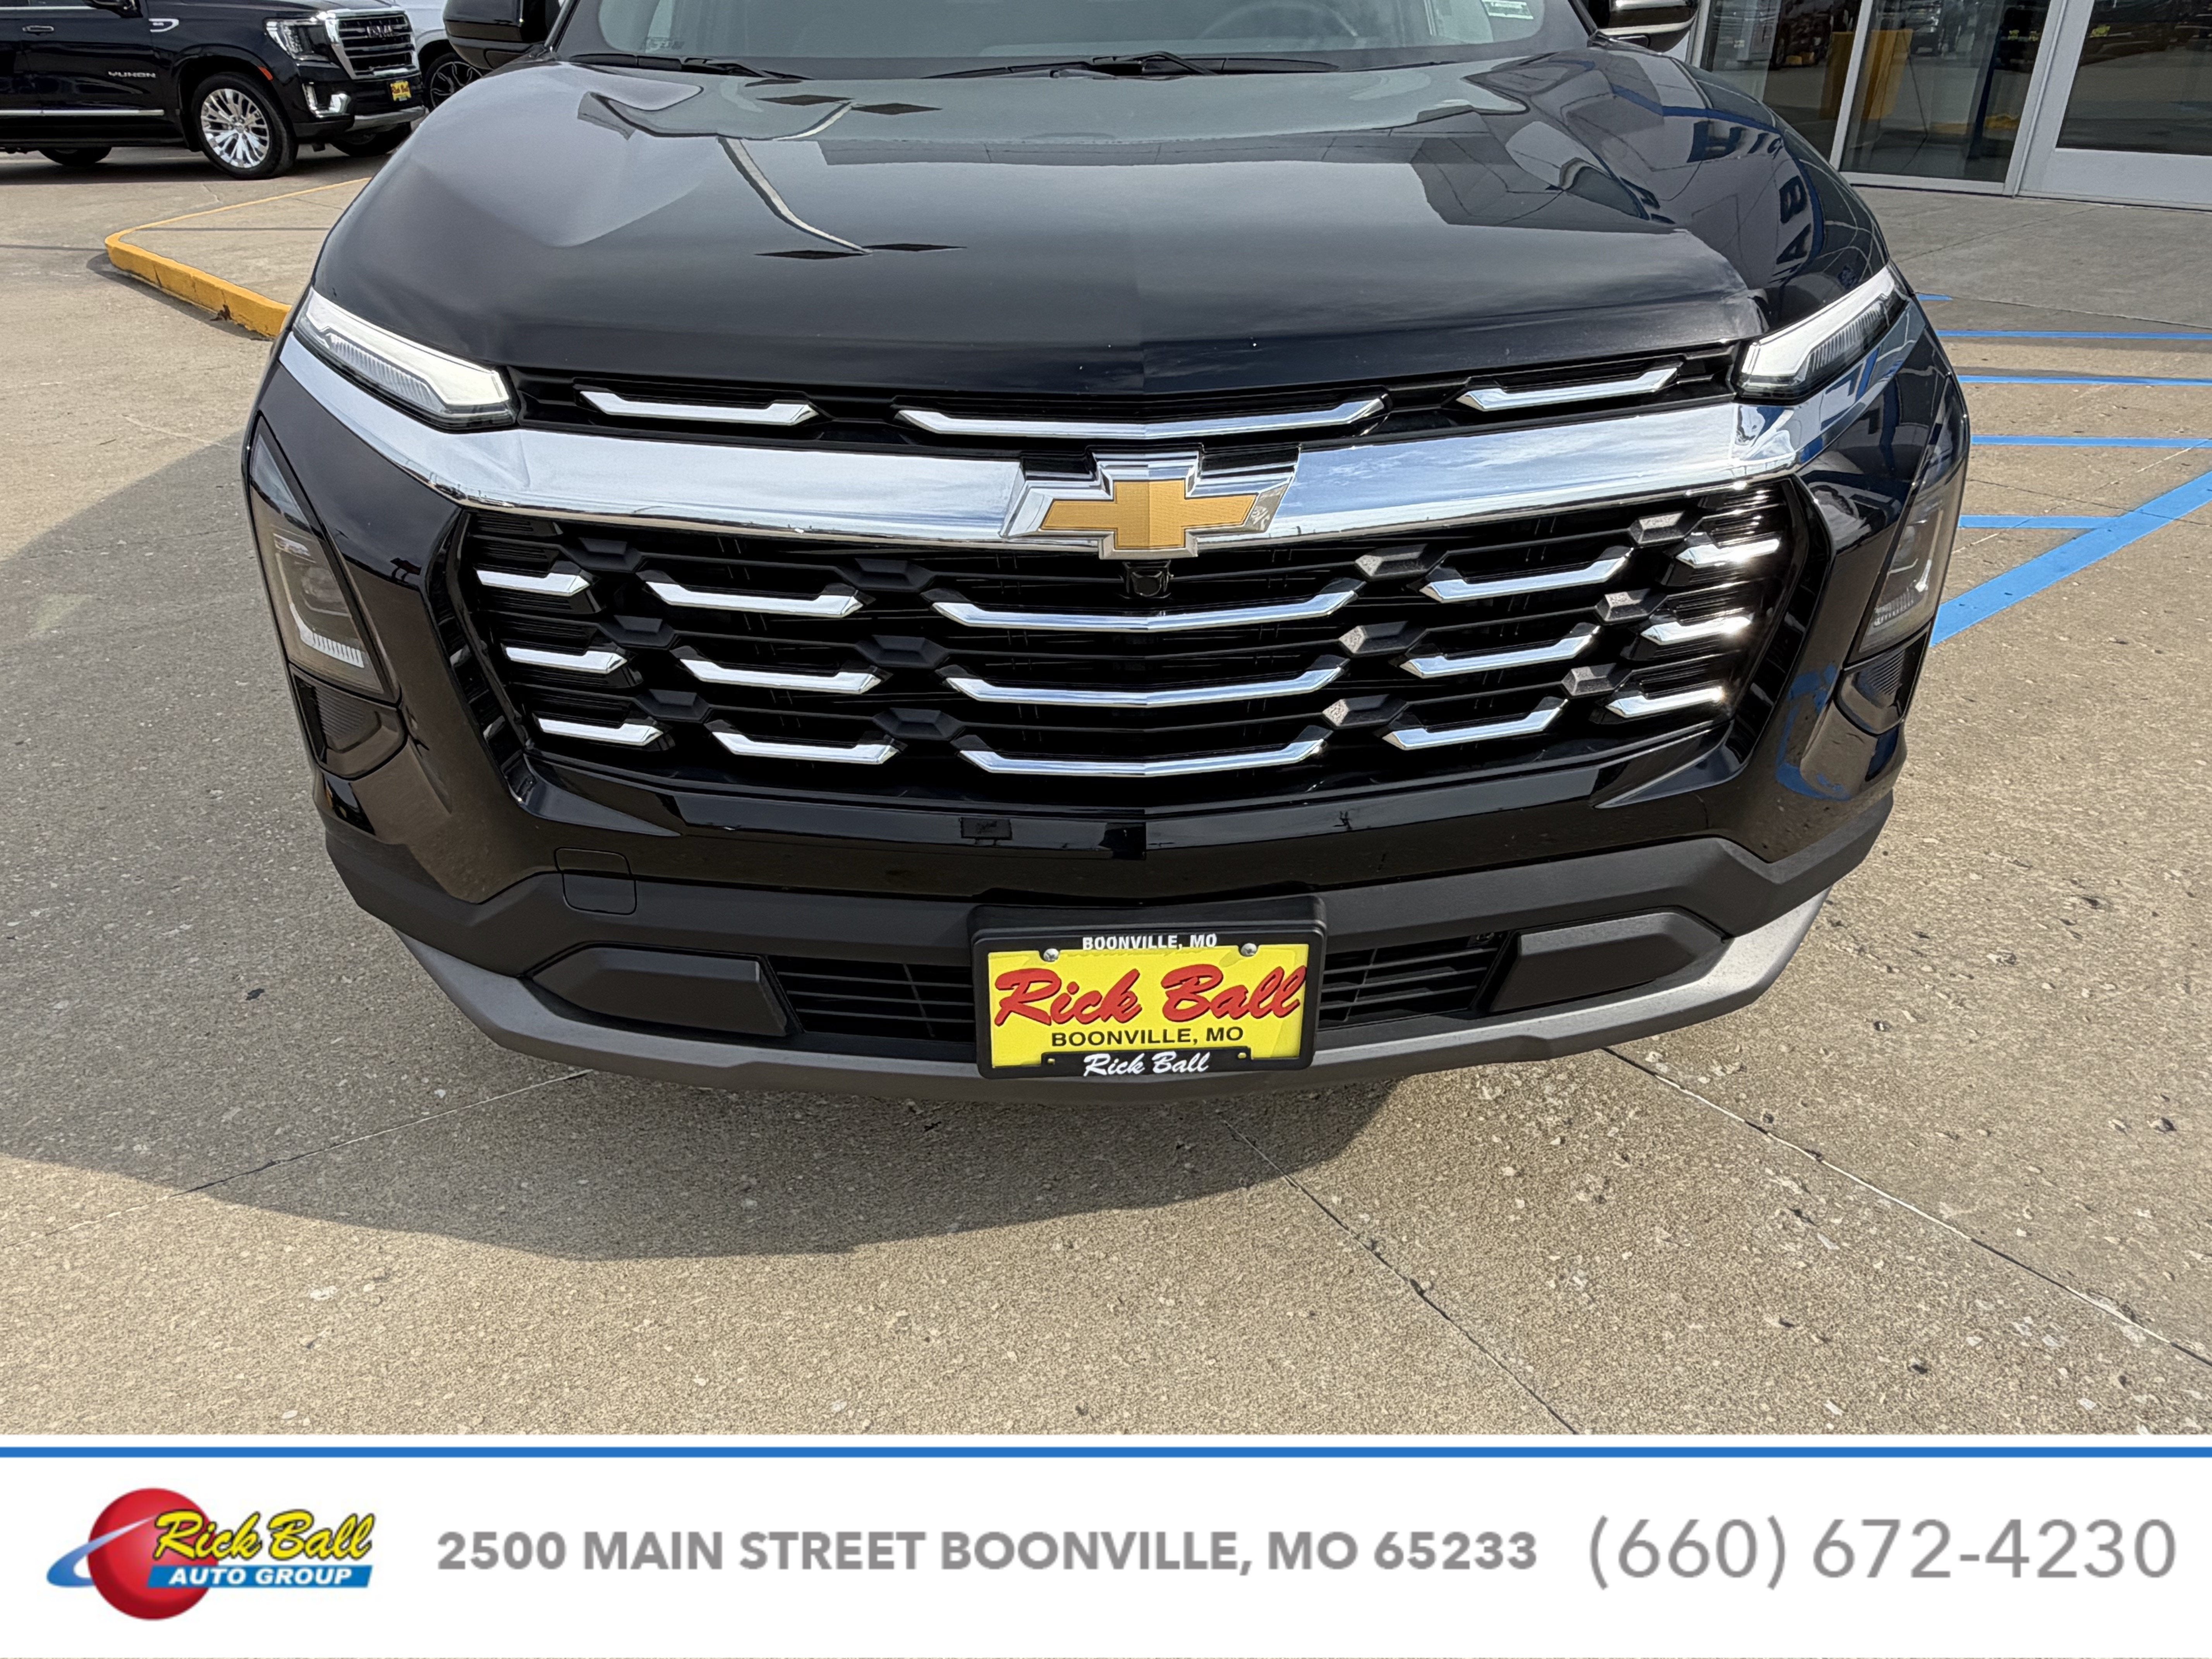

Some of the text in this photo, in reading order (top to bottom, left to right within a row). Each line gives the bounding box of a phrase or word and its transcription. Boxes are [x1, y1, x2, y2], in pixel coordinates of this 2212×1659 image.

[1082, 933, 1217, 951] BOONVILLE, MO
[994, 963, 1307, 1026] Rick Ball
[1051, 1026, 1244, 1047] BOONVILLE, MO
[1083, 1051, 1211, 1077] Rick Ball
